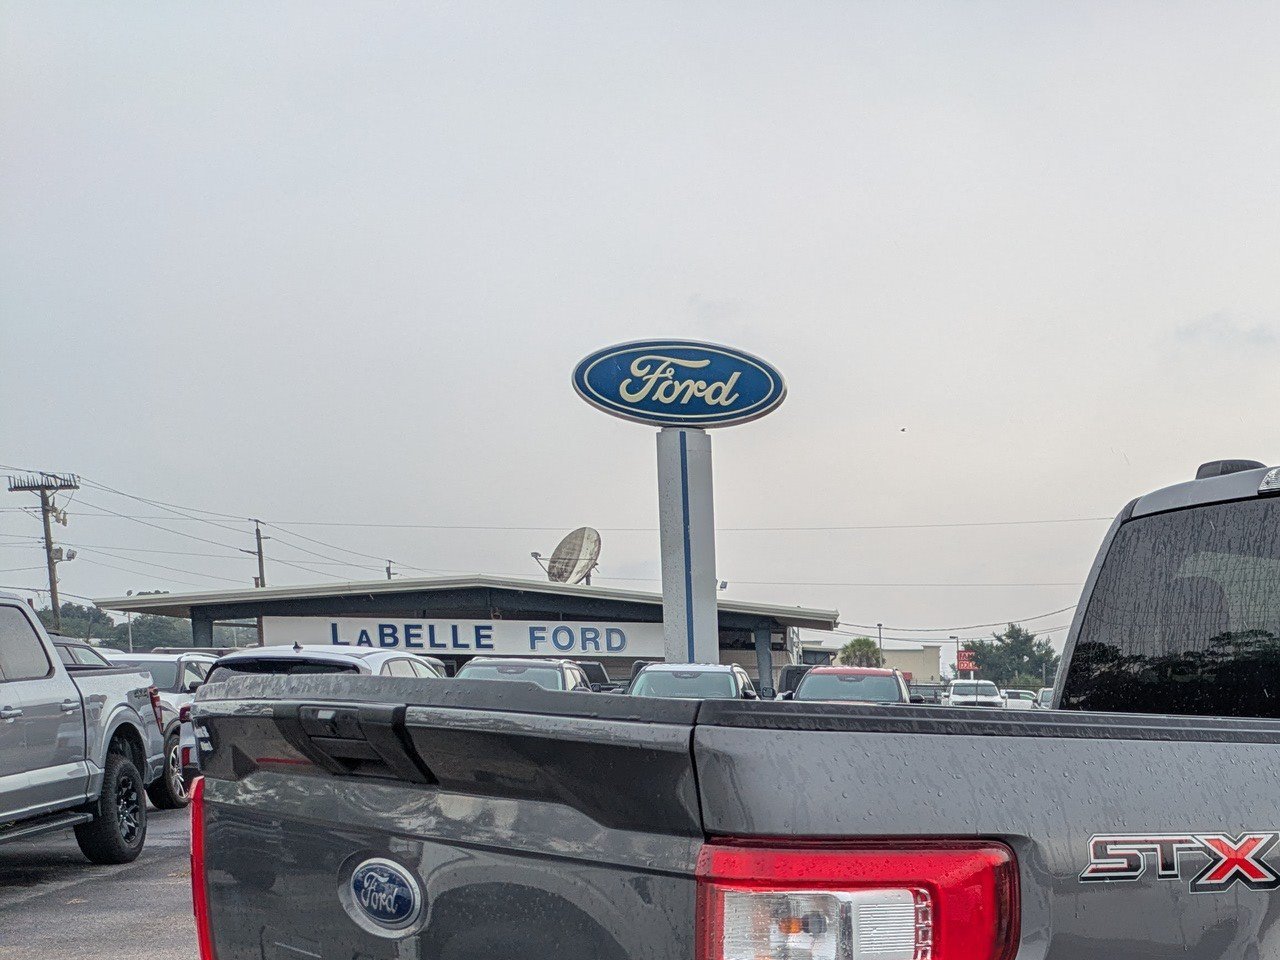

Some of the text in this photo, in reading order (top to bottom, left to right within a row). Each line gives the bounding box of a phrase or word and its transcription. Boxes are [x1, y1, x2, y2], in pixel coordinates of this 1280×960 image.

[619, 355, 742, 406] Ford
[528, 625, 628, 652] FORD
[361, 871, 399, 914] Ford
